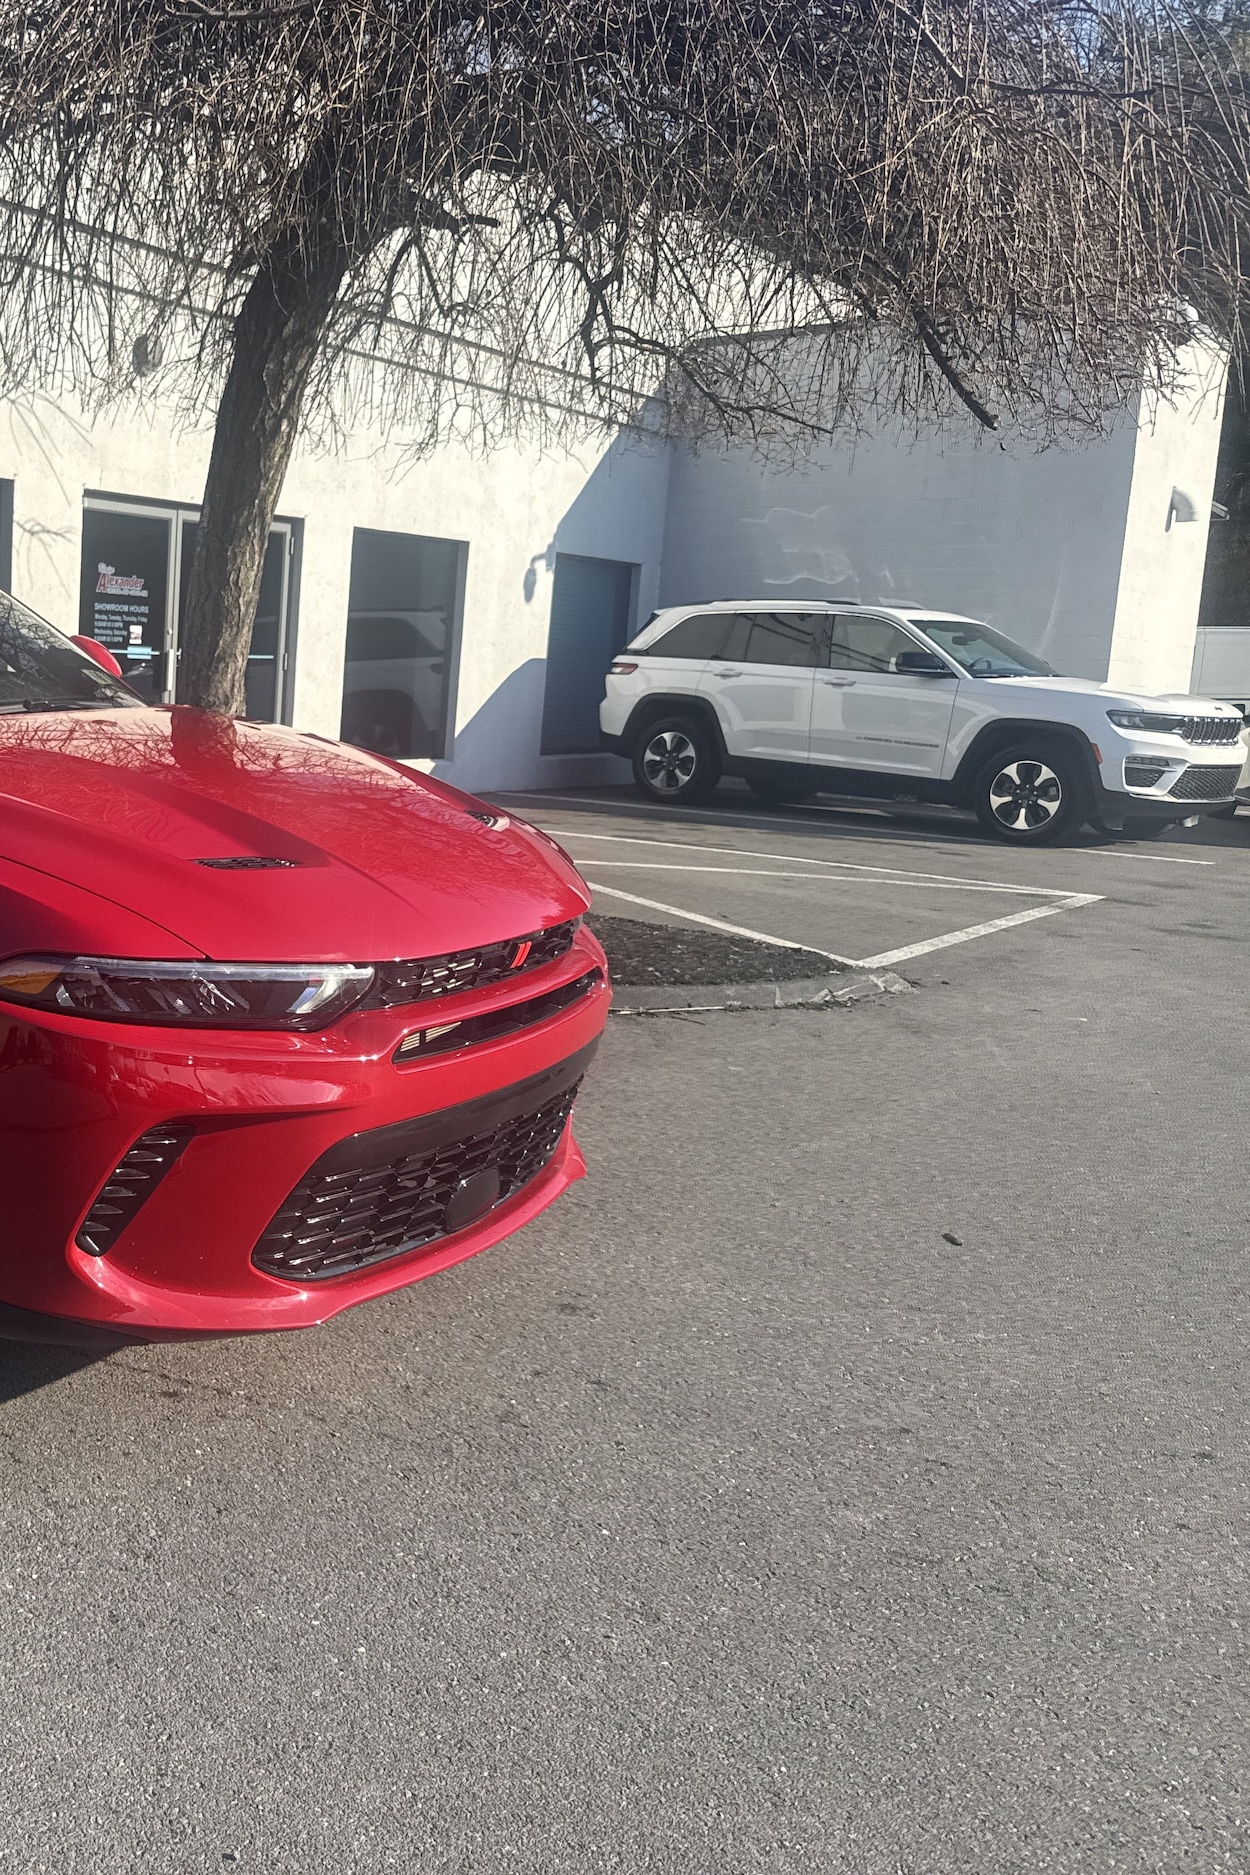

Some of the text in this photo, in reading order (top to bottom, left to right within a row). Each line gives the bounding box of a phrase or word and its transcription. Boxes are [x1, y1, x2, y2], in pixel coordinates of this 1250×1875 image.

[96, 573, 144, 593] Alexander
[94, 602, 149, 614] SHOWROOM HOURS
